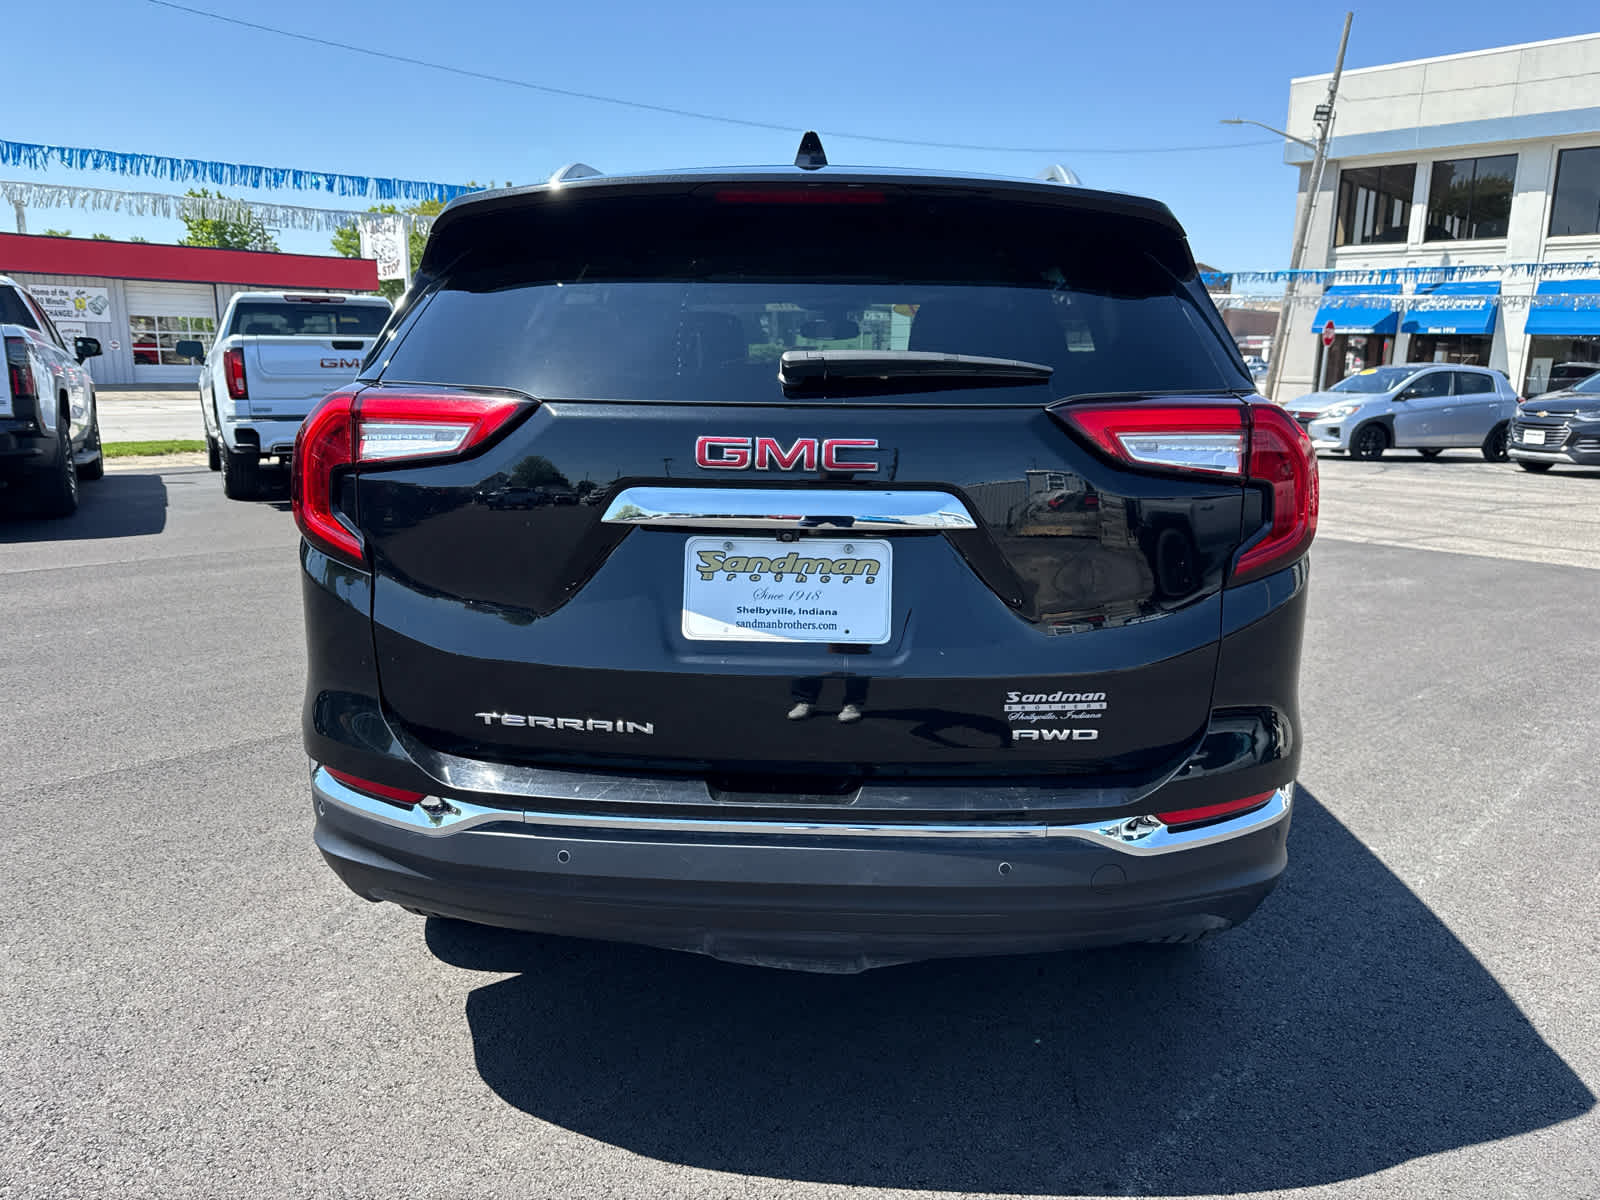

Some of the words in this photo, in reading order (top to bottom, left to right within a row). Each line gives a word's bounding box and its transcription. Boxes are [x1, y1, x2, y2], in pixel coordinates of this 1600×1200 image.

[382, 259, 401, 276] STOP
[31, 287, 49, 295] Home
[58, 288, 69, 296] the
[320, 358, 365, 369] GM
[695, 436, 880, 472] GMC
[696, 551, 881, 576] Sandman
[752, 588, 784, 601] Since
[788, 590, 823, 601] 1918
[736, 606, 796, 616] Shelbyville,
[798, 607, 838, 616] Indiana
[735, 619, 838, 631] sandmanbrothers.com
[1006, 691, 1106, 703] Sandman
[1007, 703, 1105, 711] BROTHERS
[475, 712, 654, 734] TERRAIN
[1012, 729, 1099, 741] AWD
